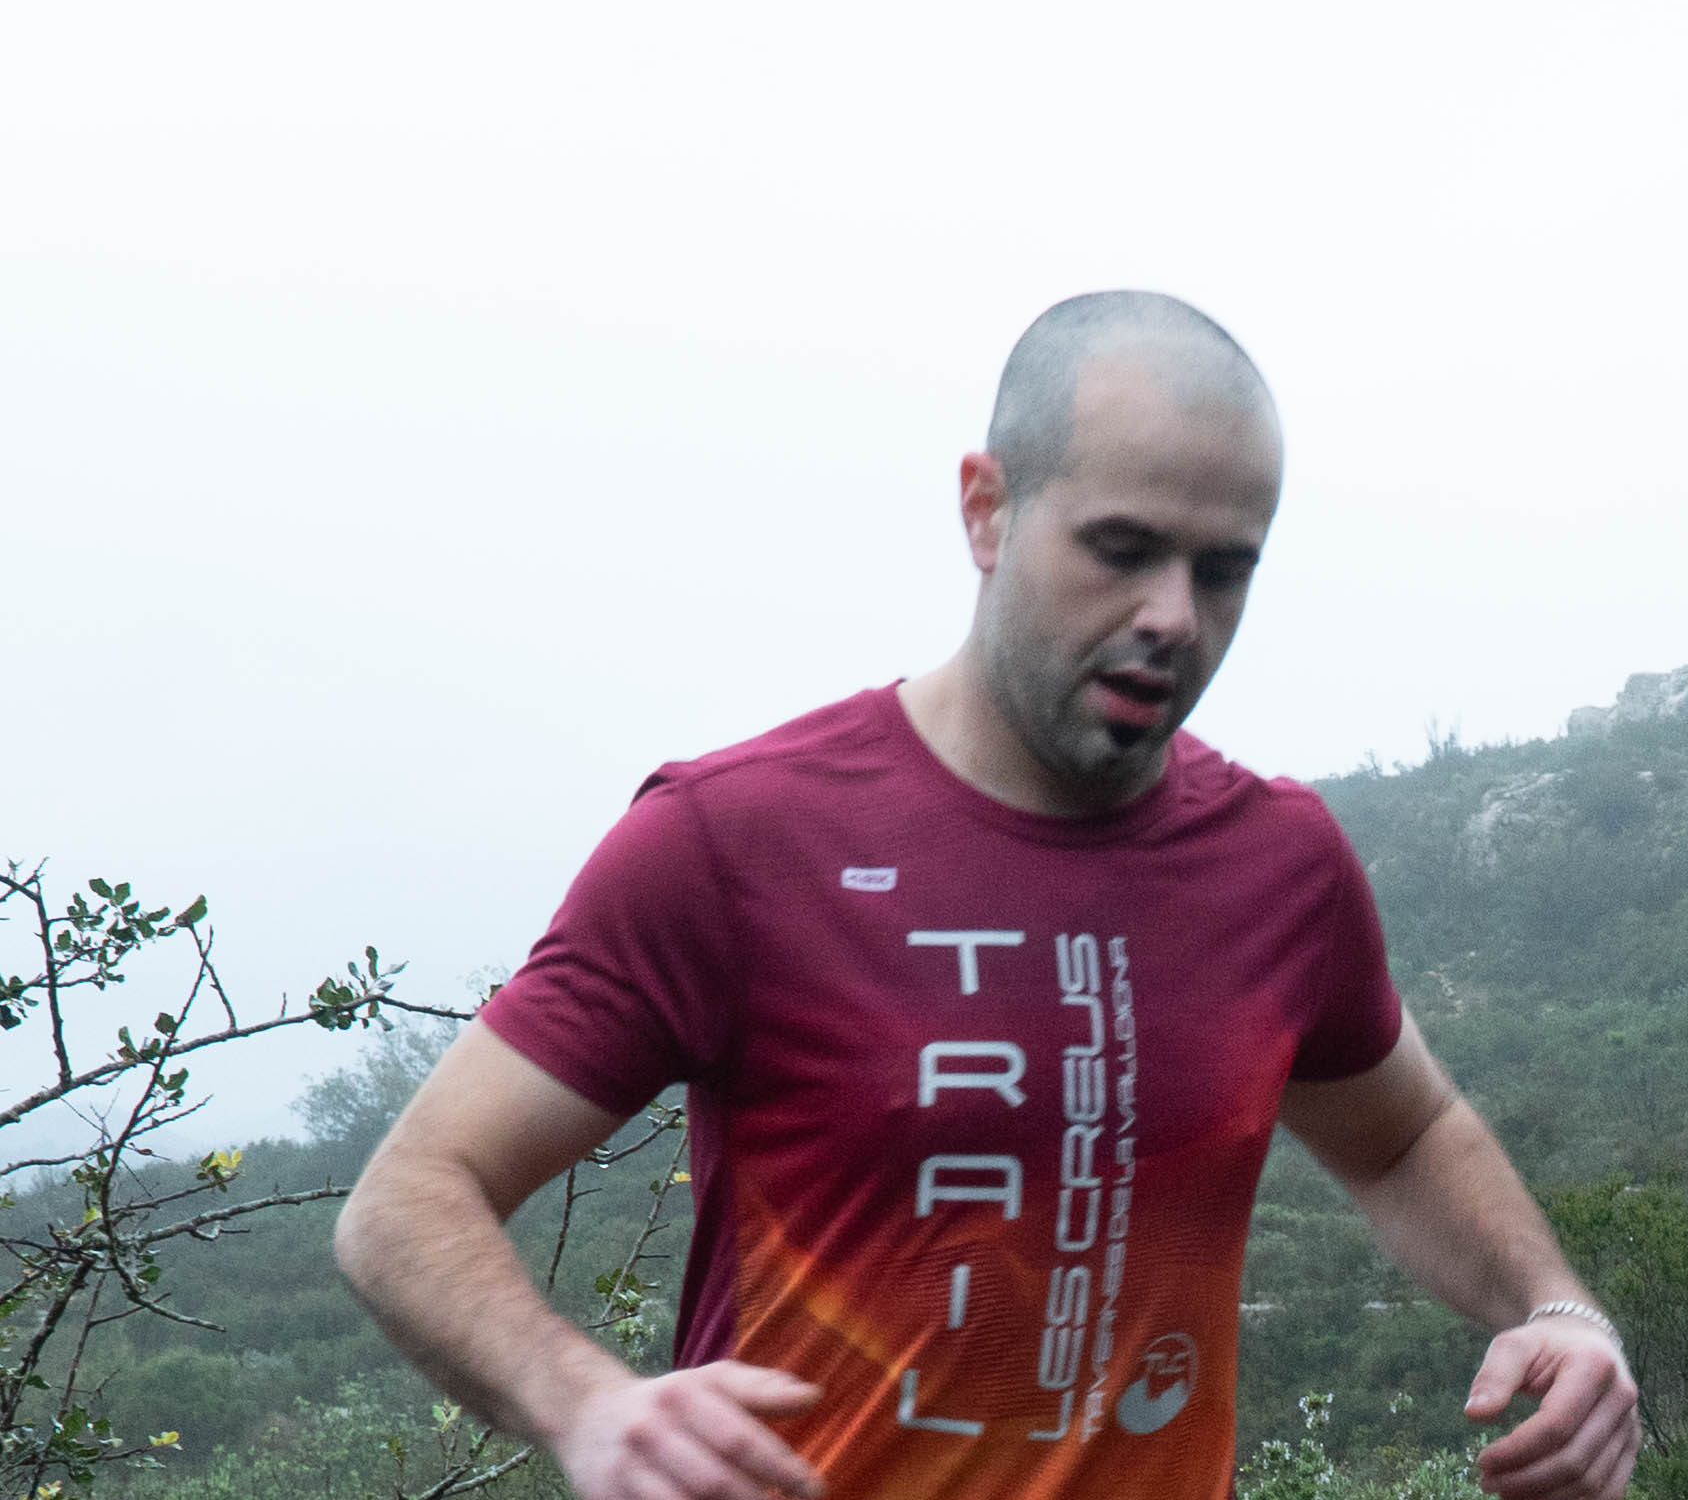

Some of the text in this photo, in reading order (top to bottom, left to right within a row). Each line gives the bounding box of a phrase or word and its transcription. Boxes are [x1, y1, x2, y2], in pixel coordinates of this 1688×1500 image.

[899, 930, 1027, 1436] TRAIL
[1028, 932, 1107, 1442] LES CREUS
